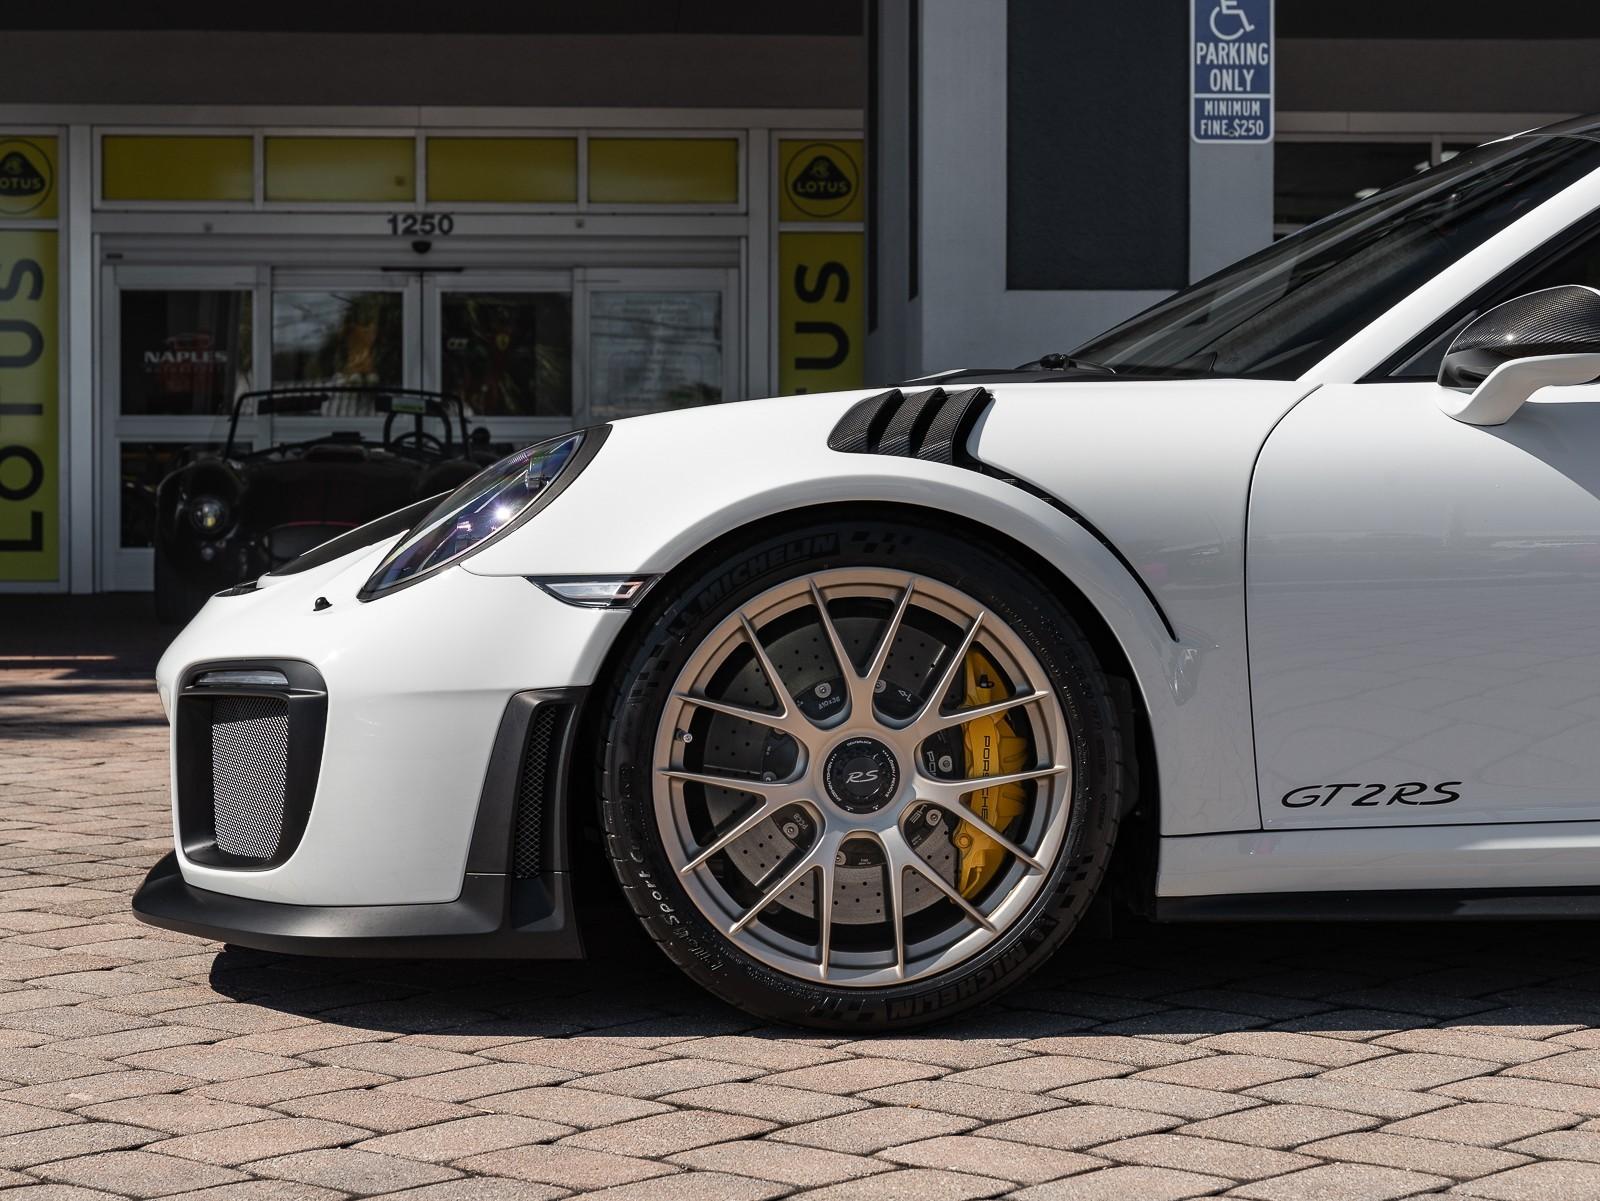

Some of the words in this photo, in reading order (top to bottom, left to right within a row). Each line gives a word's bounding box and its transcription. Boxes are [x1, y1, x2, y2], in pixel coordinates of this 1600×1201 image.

[1196, 42, 1269, 65] PARKING
[1209, 68, 1255, 92] ONLY
[1204, 101, 1261, 117] MINIMUM
[1200, 119, 1229, 137] FINE
[1233, 118, 1265, 138] $250
[0, 177, 41, 191] OTUS
[796, 180, 850, 195] LOTUS
[387, 214, 454, 235] 1250
[143, 350, 229, 364] NAPLES
[696, 533, 838, 610] MICHELIN
[845, 769, 879, 784] RS
[638, 869, 682, 926] Sport
[891, 941, 1029, 1019] MICHELIN
